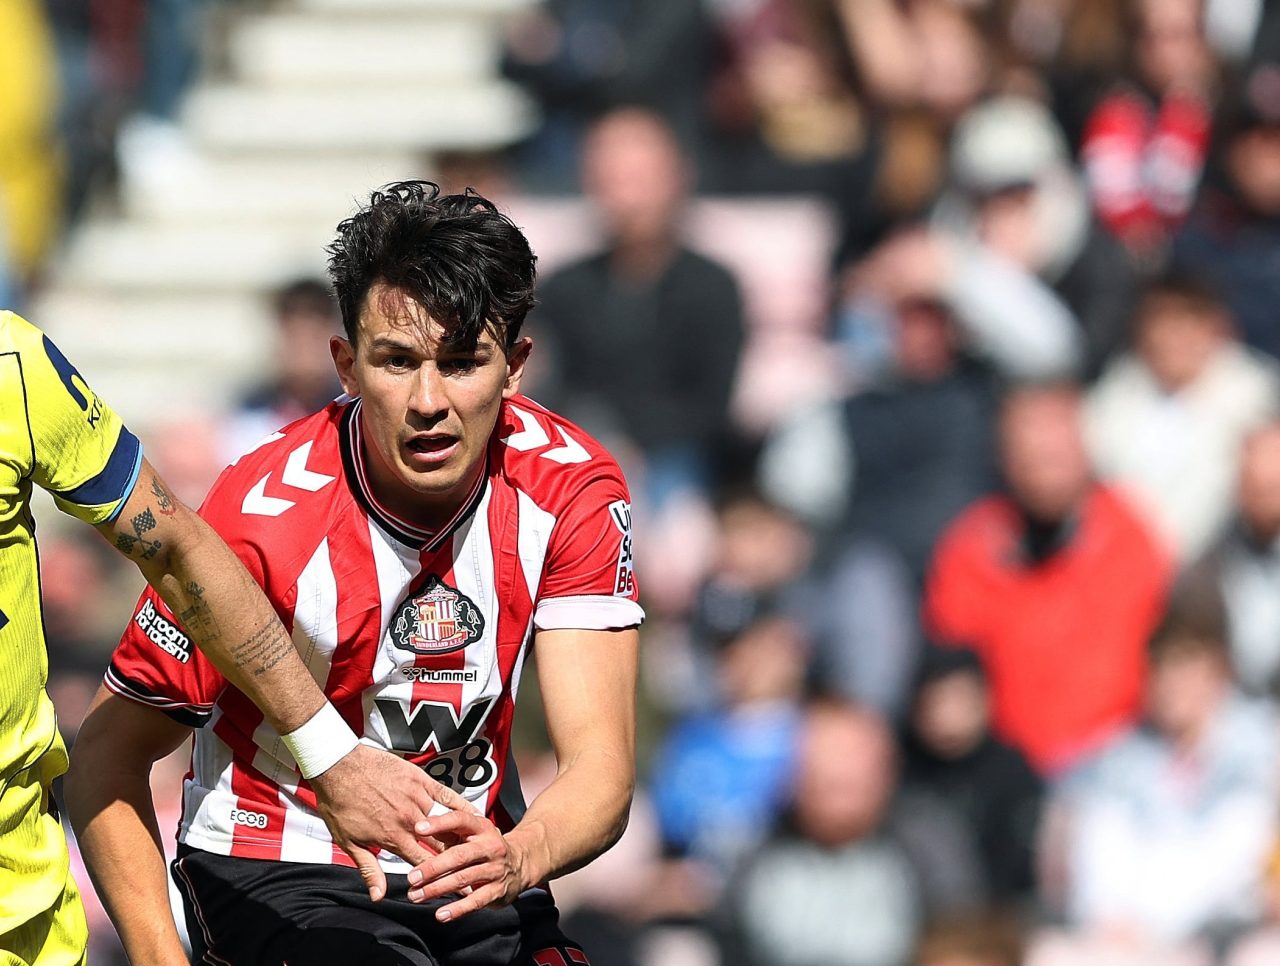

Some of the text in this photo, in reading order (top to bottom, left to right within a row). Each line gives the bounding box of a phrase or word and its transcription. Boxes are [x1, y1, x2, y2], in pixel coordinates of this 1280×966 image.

[141, 598, 189, 649] No room
[146, 624, 190, 664] racism
[421, 668, 477, 682] hummel
[374, 699, 493, 752] W
